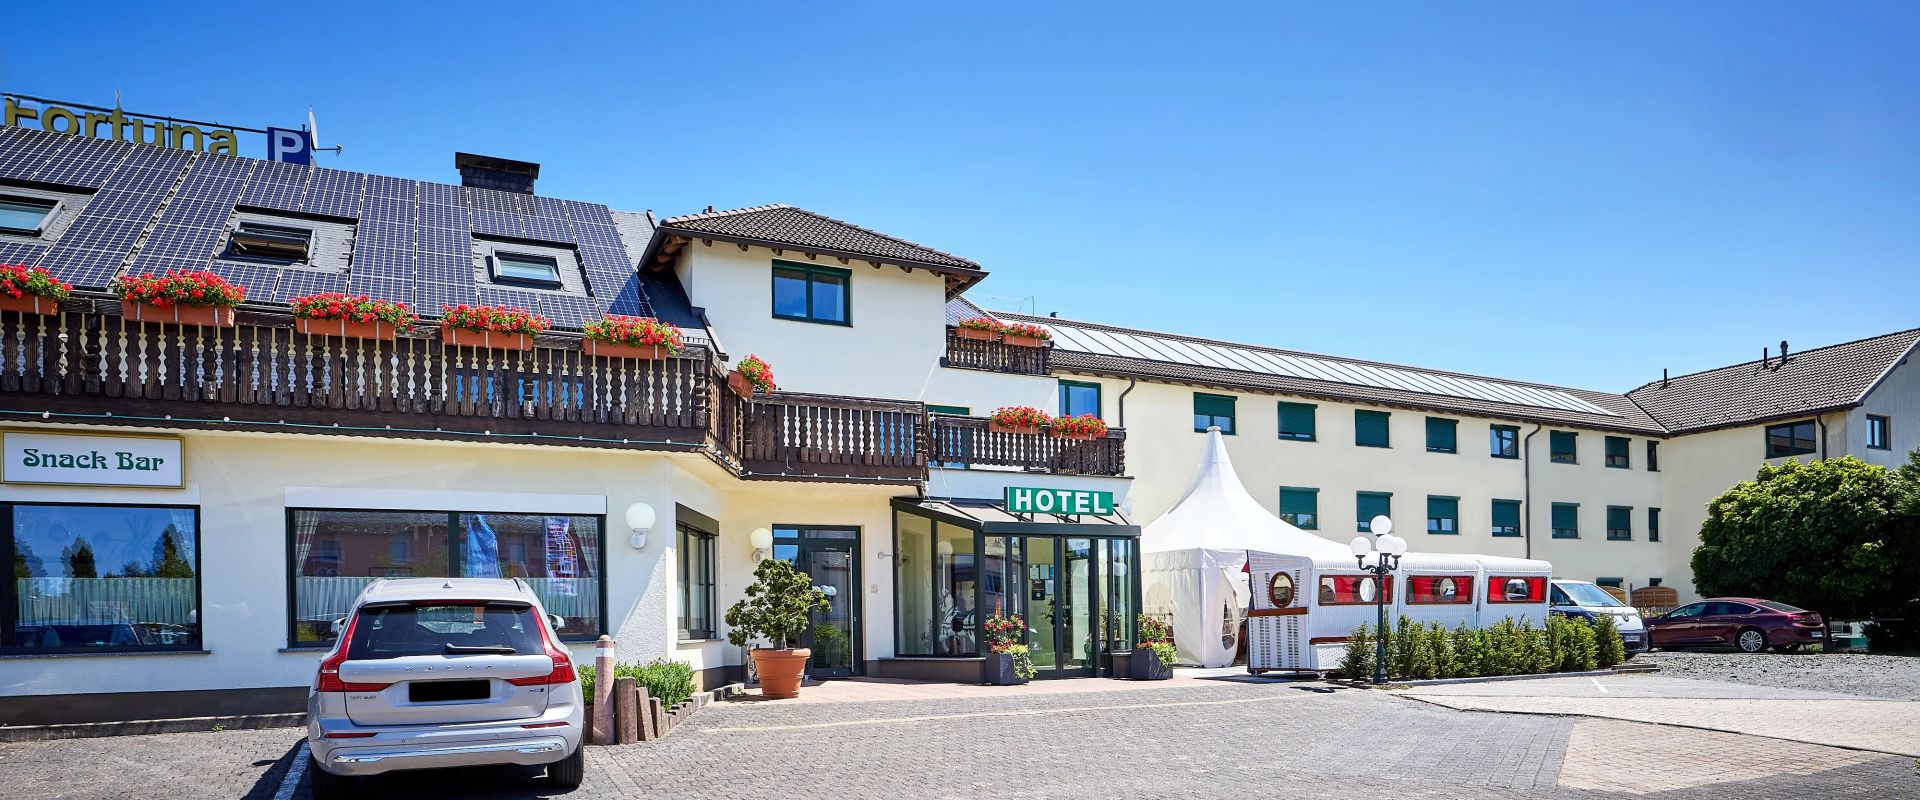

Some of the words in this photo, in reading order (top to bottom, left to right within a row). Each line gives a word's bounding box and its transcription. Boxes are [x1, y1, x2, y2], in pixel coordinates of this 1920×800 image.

[5, 97, 238, 157] Fortuna
[274, 130, 304, 162] P
[23, 448, 109, 470] Snack
[115, 451, 164, 471] Bar
[1015, 488, 1108, 514] HOTEL
